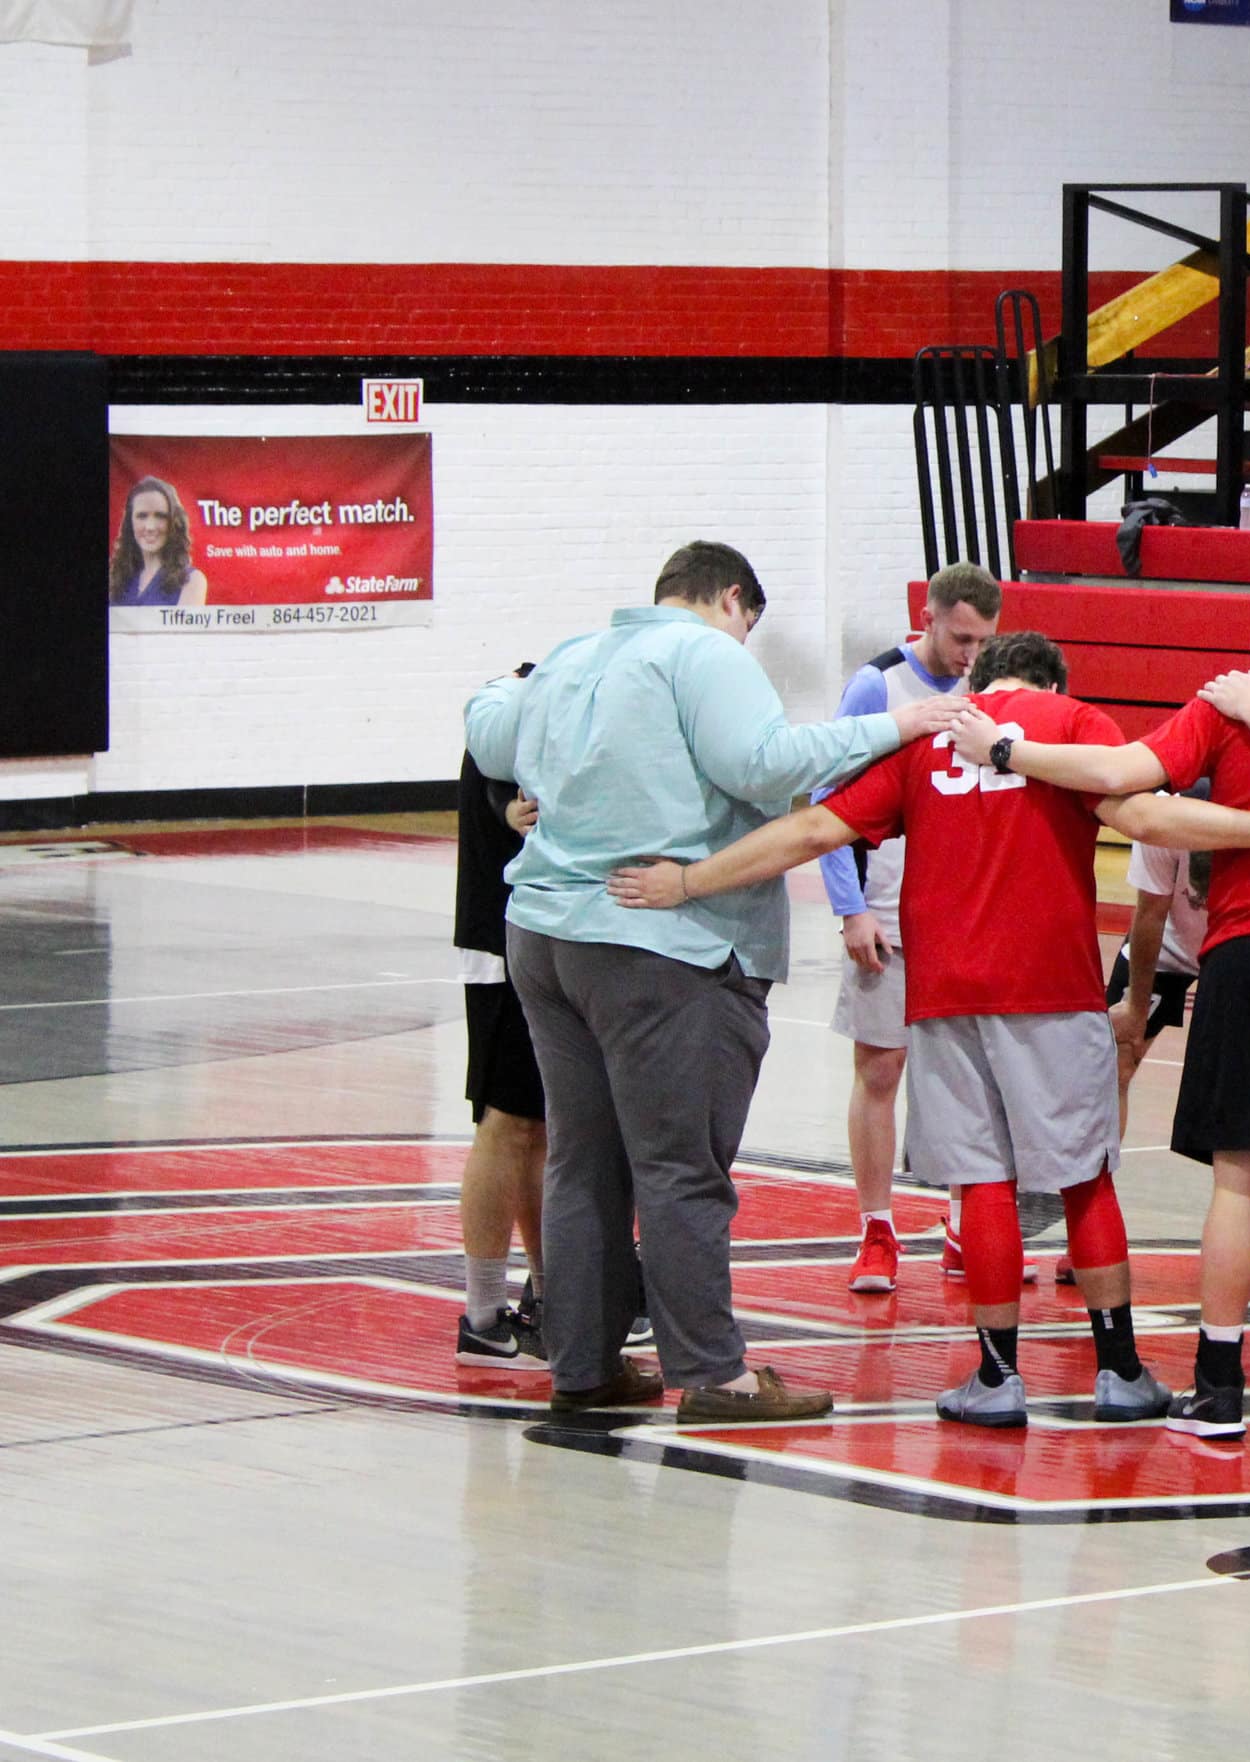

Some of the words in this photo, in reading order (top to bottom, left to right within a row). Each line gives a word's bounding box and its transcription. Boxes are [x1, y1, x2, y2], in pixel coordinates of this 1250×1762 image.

[368, 383, 419, 421] EXIT
[197, 499, 242, 526] The
[249, 499, 333, 532] perfect
[338, 496, 415, 525] match.
[206, 544, 233, 557] Save
[235, 544, 257, 557] with
[260, 544, 283, 557] auto
[286, 544, 307, 556] and
[160, 608, 212, 629] Tiffany
[216, 608, 256, 625] Freel
[272, 604, 377, 624] 864-457-2021
[931, 721, 1027, 795] 32
